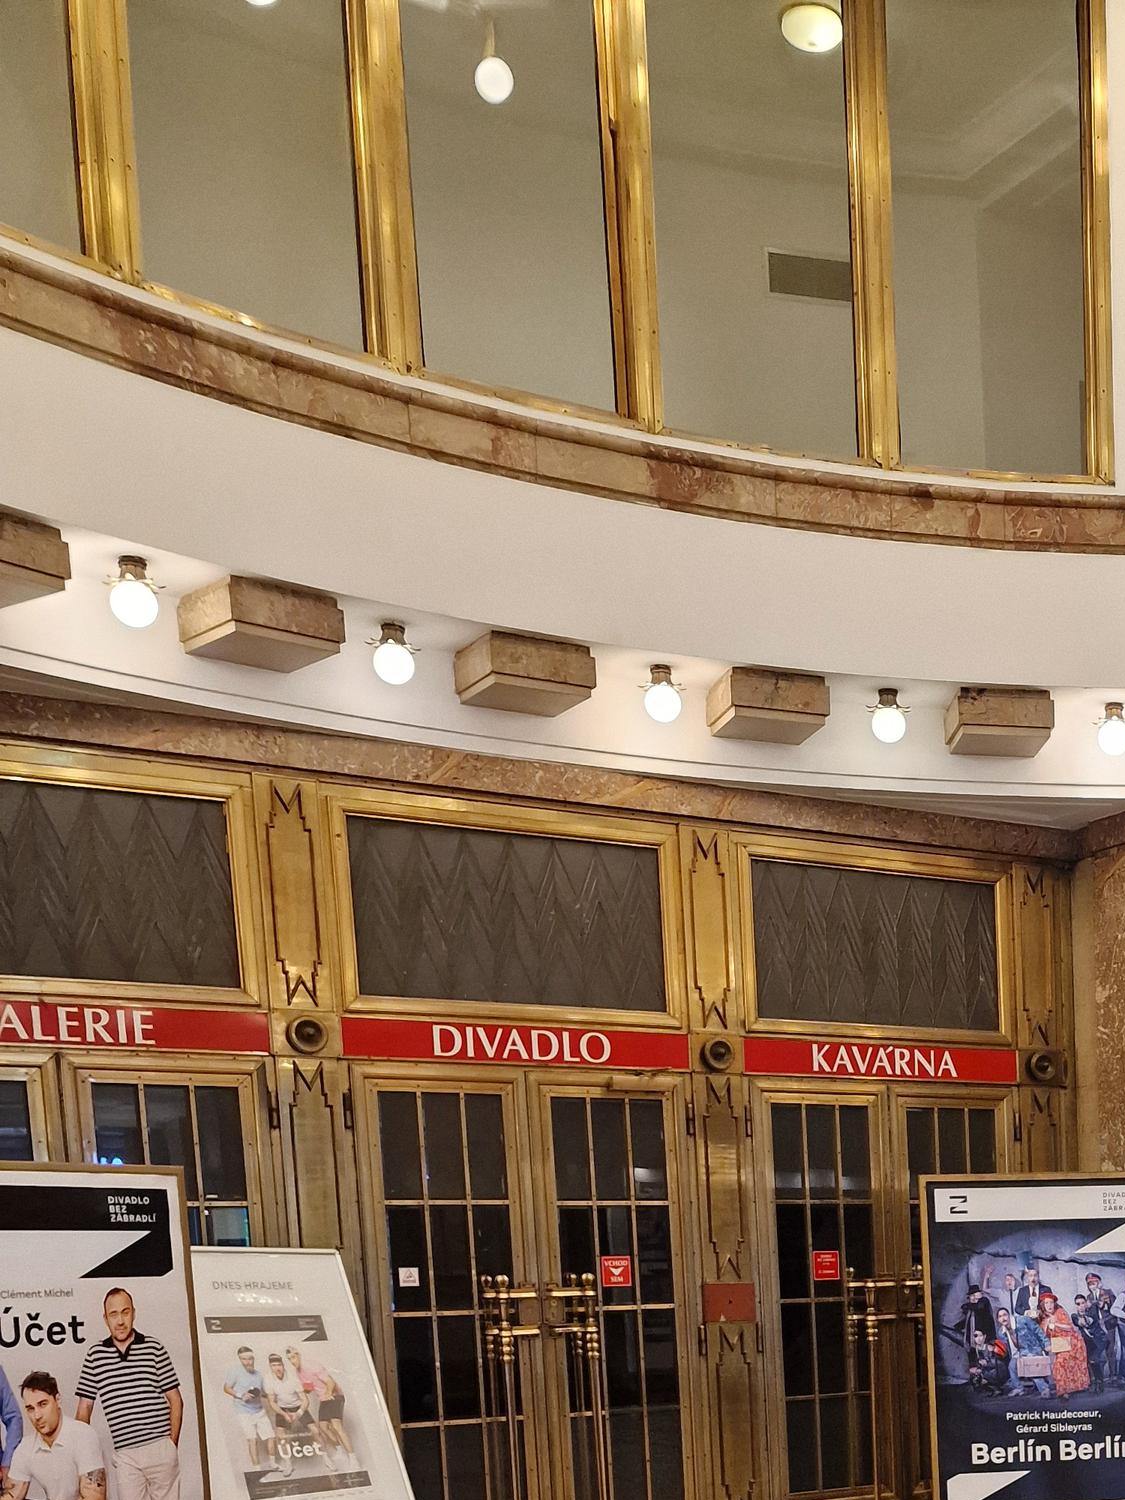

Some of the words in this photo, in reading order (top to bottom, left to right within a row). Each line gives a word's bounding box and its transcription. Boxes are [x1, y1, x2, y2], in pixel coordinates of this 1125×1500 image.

[0, 1003, 156, 1045] ALERIE
[432, 1024, 612, 1063] DIVADLO
[811, 1043, 958, 1078] KAVÁRNA
[107, 1195, 150, 1205] DIVADLO
[109, 1205, 127, 1213] BEZ
[110, 1213, 157, 1223] ZÁBRADLÍ
[212, 1281, 242, 1290] DNES
[244, 1281, 294, 1290] HRAJEME
[0, 1289, 43, 1300] Clément
[44, 1288, 74, 1298] Michel
[0, 1306, 87, 1348] Účet
[1006, 1411, 1041, 1421] Patrick
[1042, 1410, 1102, 1420] Haudecoeur,
[1016, 1424, 1049, 1434] Gérard
[1050, 1423, 1093, 1434] Sibleyras
[277, 1440, 326, 1459] Účet
[971, 1438, 1051, 1465] Berlín
